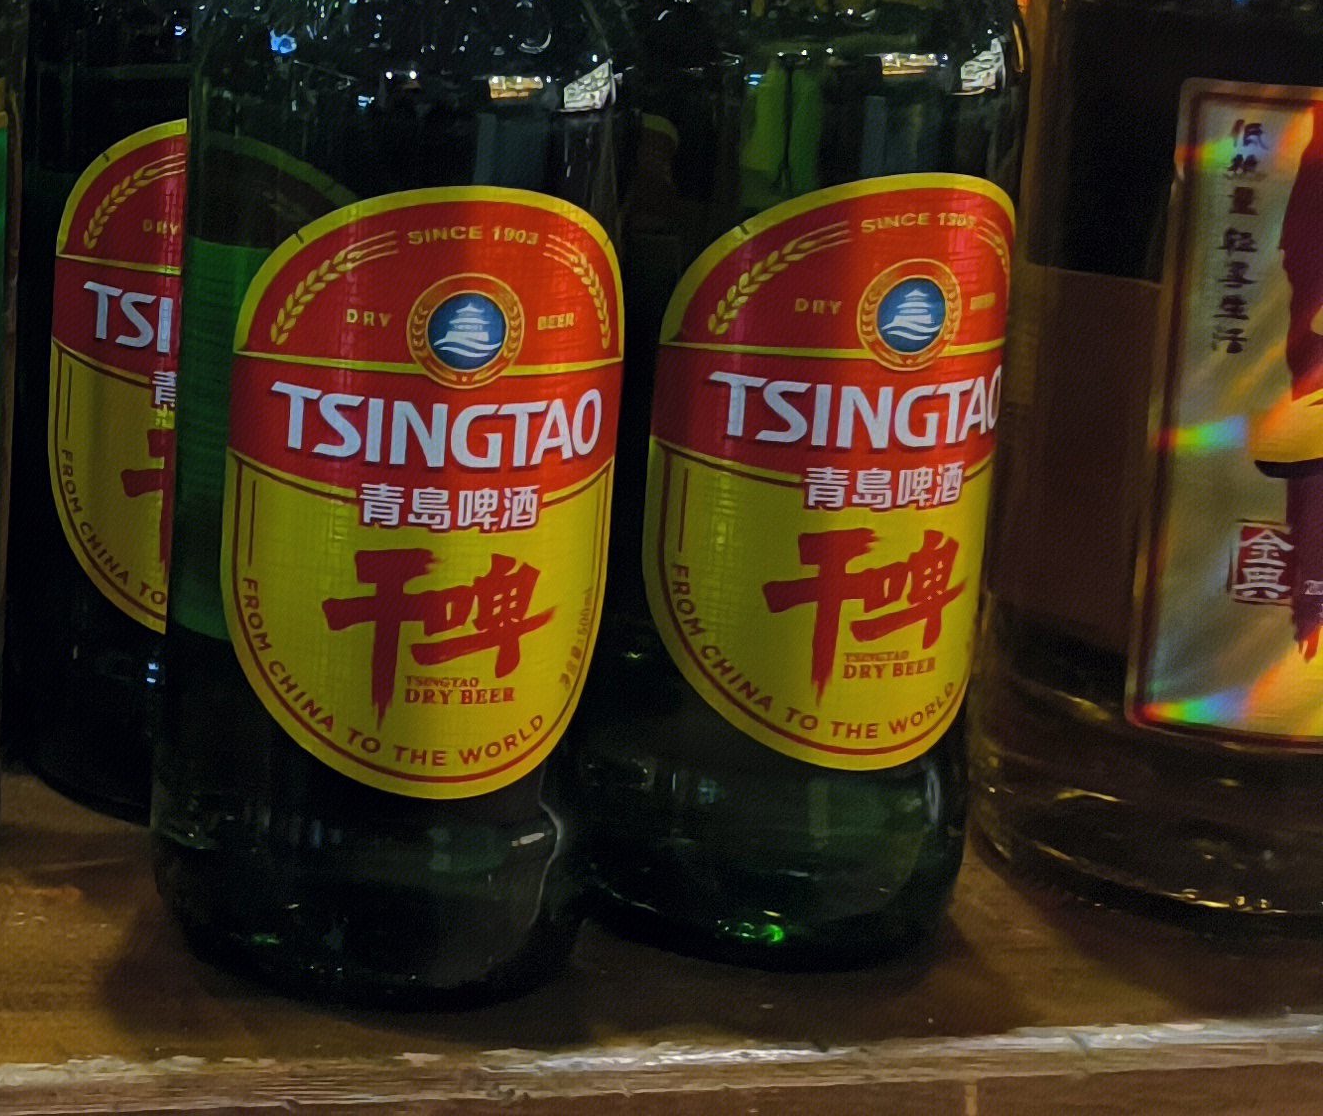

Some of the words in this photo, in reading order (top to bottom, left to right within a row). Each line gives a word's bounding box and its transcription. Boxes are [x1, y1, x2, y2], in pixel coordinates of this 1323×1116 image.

[860, 212, 931, 235] SINCE
[406, 225, 484, 246] SINCE
[345, 307, 393, 329] DRY
[794, 297, 843, 316] DRY
[270, 380, 603, 469] TSINGTAO
[58, 449, 84, 514] FROM
[79, 519, 130, 588] CHINA
[137, 580, 167, 606] TO
[761, 527, 967, 708] 干啤
[321, 546, 559, 732] 干啤
[669, 563, 706, 638] FROM
[700, 643, 775, 712] CHINA
[785, 706, 820, 732] TO
[830, 720, 880, 740] THE
[887, 680, 955, 735] WORLD
[240, 576, 273, 653] FROM
[268, 658, 337, 734] CHINA
[346, 727, 381, 754] TO
[392, 744, 447, 768] THE
[457, 713, 546, 767] WORLD
[842, 663, 887, 680] DRY
[891, 657, 936, 678] BEER
[404, 675, 480, 689] TSINGTAO
[404, 687, 453, 704] DRY
[458, 687, 516, 704] BEER
